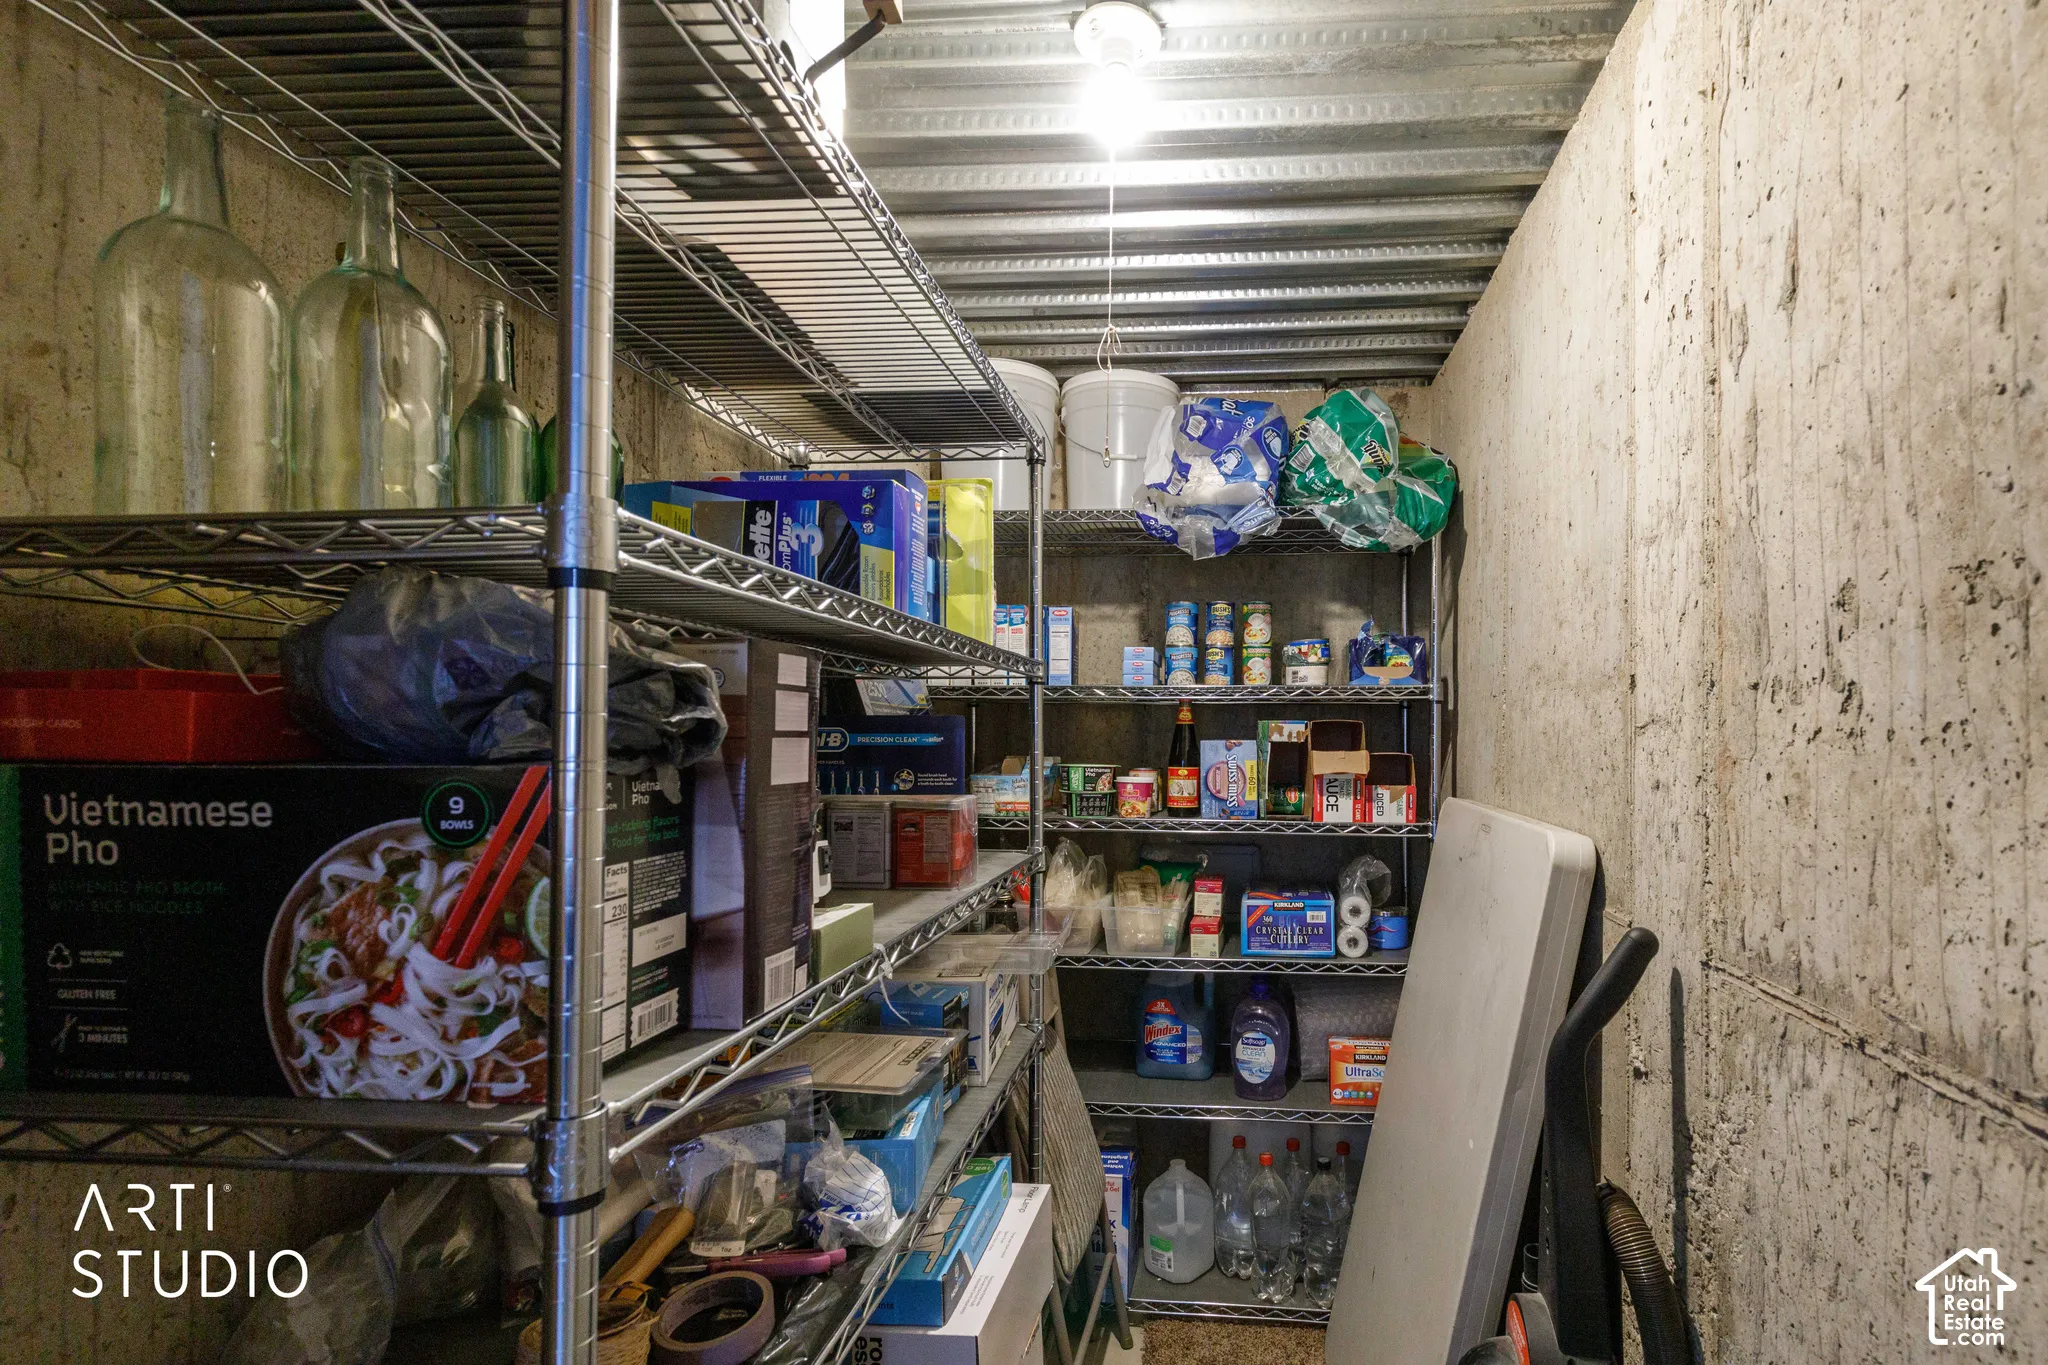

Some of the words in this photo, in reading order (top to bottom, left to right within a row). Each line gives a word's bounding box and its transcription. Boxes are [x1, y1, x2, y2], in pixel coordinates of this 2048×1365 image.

[749, 507, 773, 564] ette
[776, 512, 793, 572] omPlus
[788, 522, 825, 557] 3
[1211, 606, 1231, 614] BUSH'S
[1206, 651, 1224, 659] BUSH'S
[1226, 754, 1238, 782] SWISS
[1248, 776, 1256, 786] 60
[631, 793, 650, 806] Pho
[1326, 778, 1339, 813] AUCE
[43, 791, 273, 828] Vietnamese
[448, 796, 465, 815] 9
[1376, 792, 1385, 817] DICED
[440, 820, 474, 830] BOWLS
[46, 830, 119, 866] Pho
[606, 865, 628, 878] Facts
[611, 902, 628, 918] 230
[1262, 915, 1273, 923] 360
[1255, 925, 1292, 935] CRYSTAL
[1297, 926, 1324, 935] CLEAR
[1270, 934, 1309, 944] CUTLERY
[57, 989, 94, 1000] GLUTEN
[95, 989, 117, 1000] FREE
[87, 1033, 129, 1043] MINUTES
[1145, 1024, 1182, 1045] Windex
[1242, 1038, 1266, 1046] Softsoap
[1241, 1050, 1266, 1058] CLEAN
[1026, 1186, 1040, 1201] Floor
[1018, 1198, 1031, 1214] Lamp
